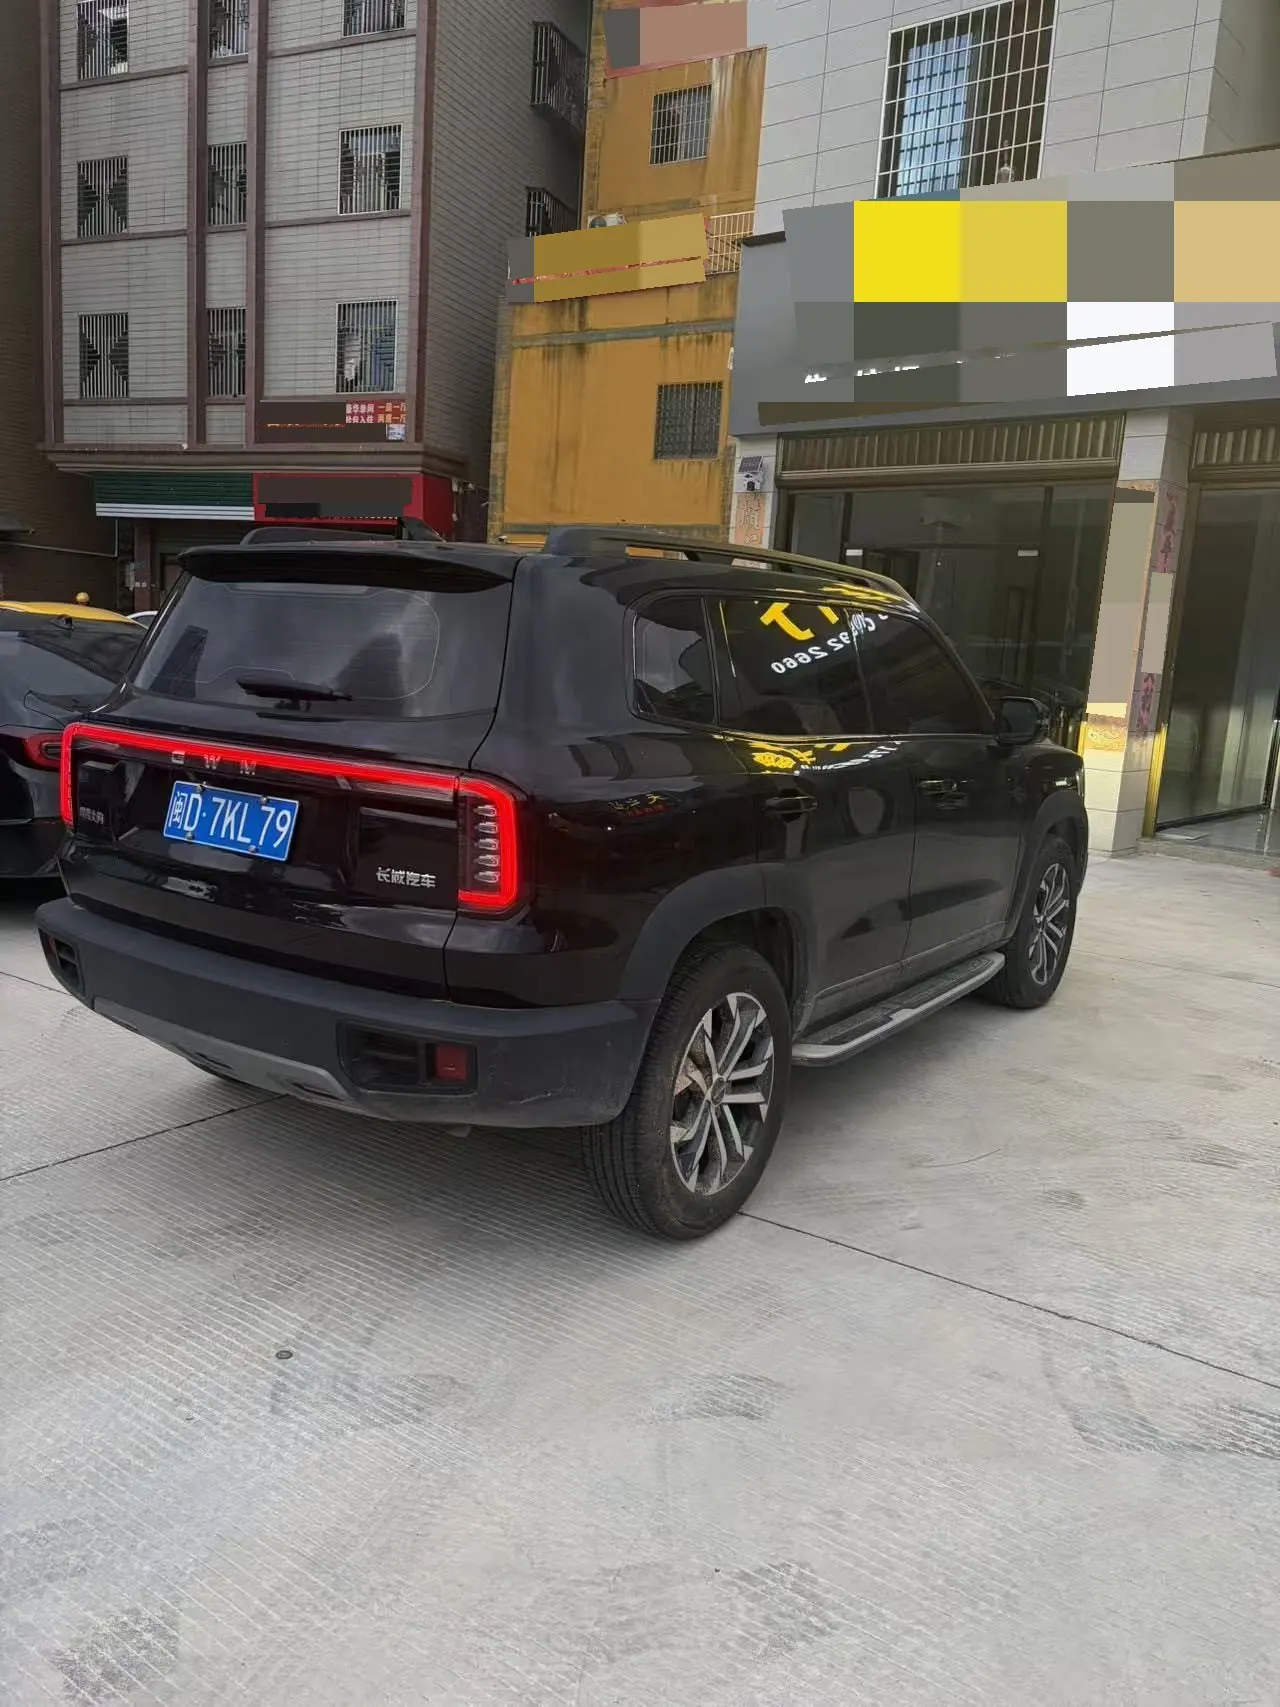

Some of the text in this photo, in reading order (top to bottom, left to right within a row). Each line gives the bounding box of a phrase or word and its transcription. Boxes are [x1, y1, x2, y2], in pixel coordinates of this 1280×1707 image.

[171, 750, 257, 776] GWM
[375, 866, 436, 888] 长城汽车
